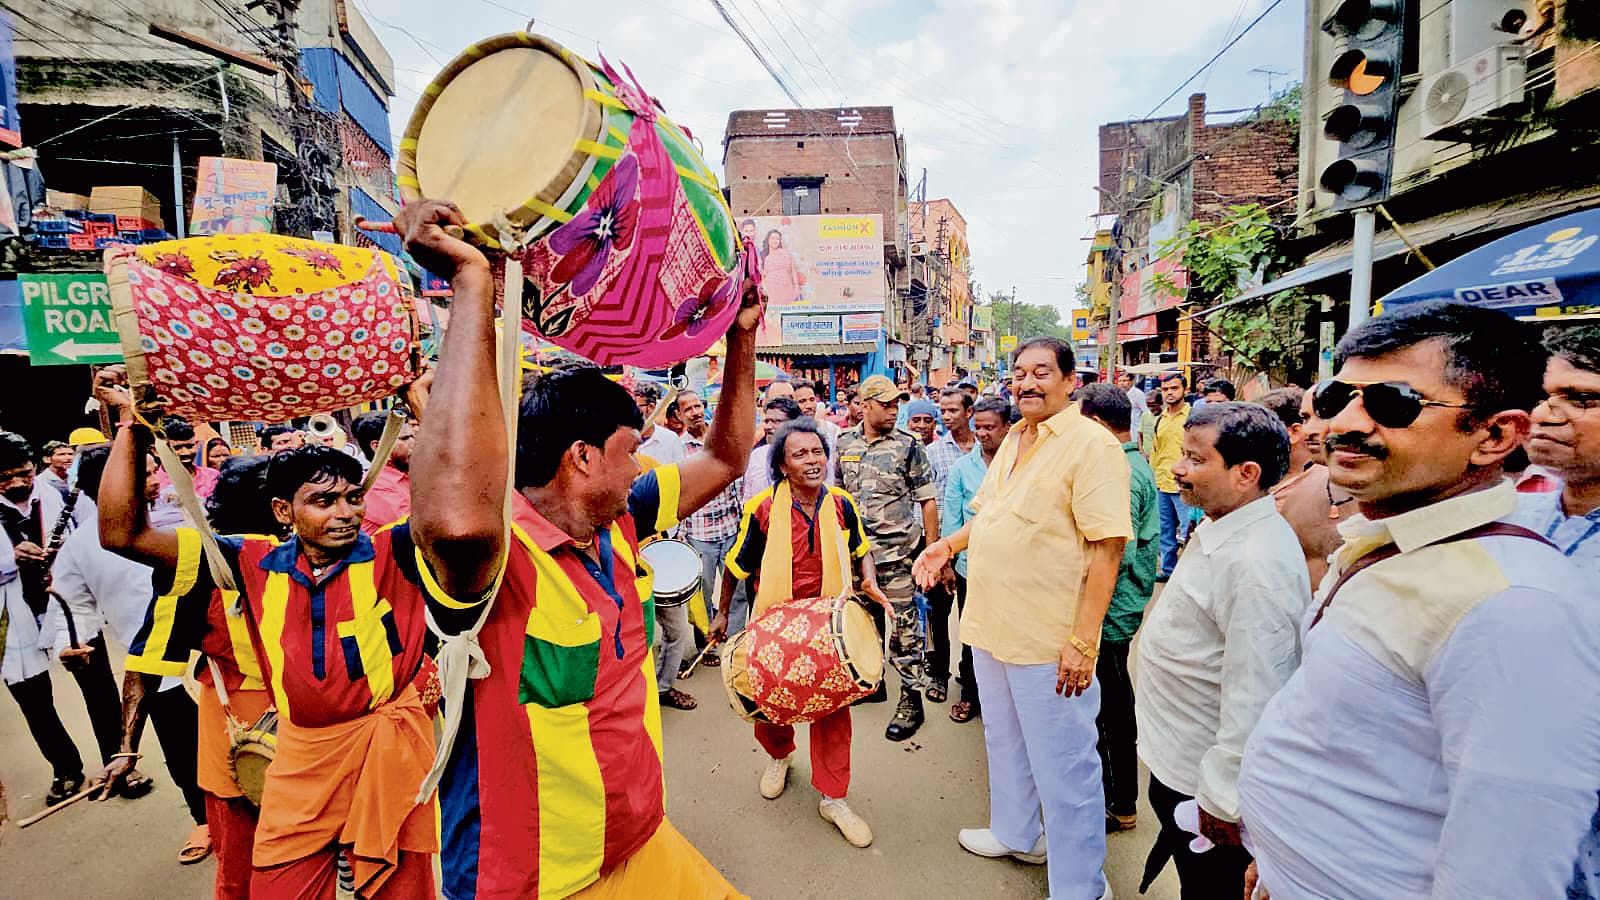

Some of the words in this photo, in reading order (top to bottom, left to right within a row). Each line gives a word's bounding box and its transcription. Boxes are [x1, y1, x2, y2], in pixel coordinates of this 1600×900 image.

[823, 223, 859, 232] FASHION
[22, 281, 112, 306] PILGR
[1460, 281, 1552, 303] DEAR
